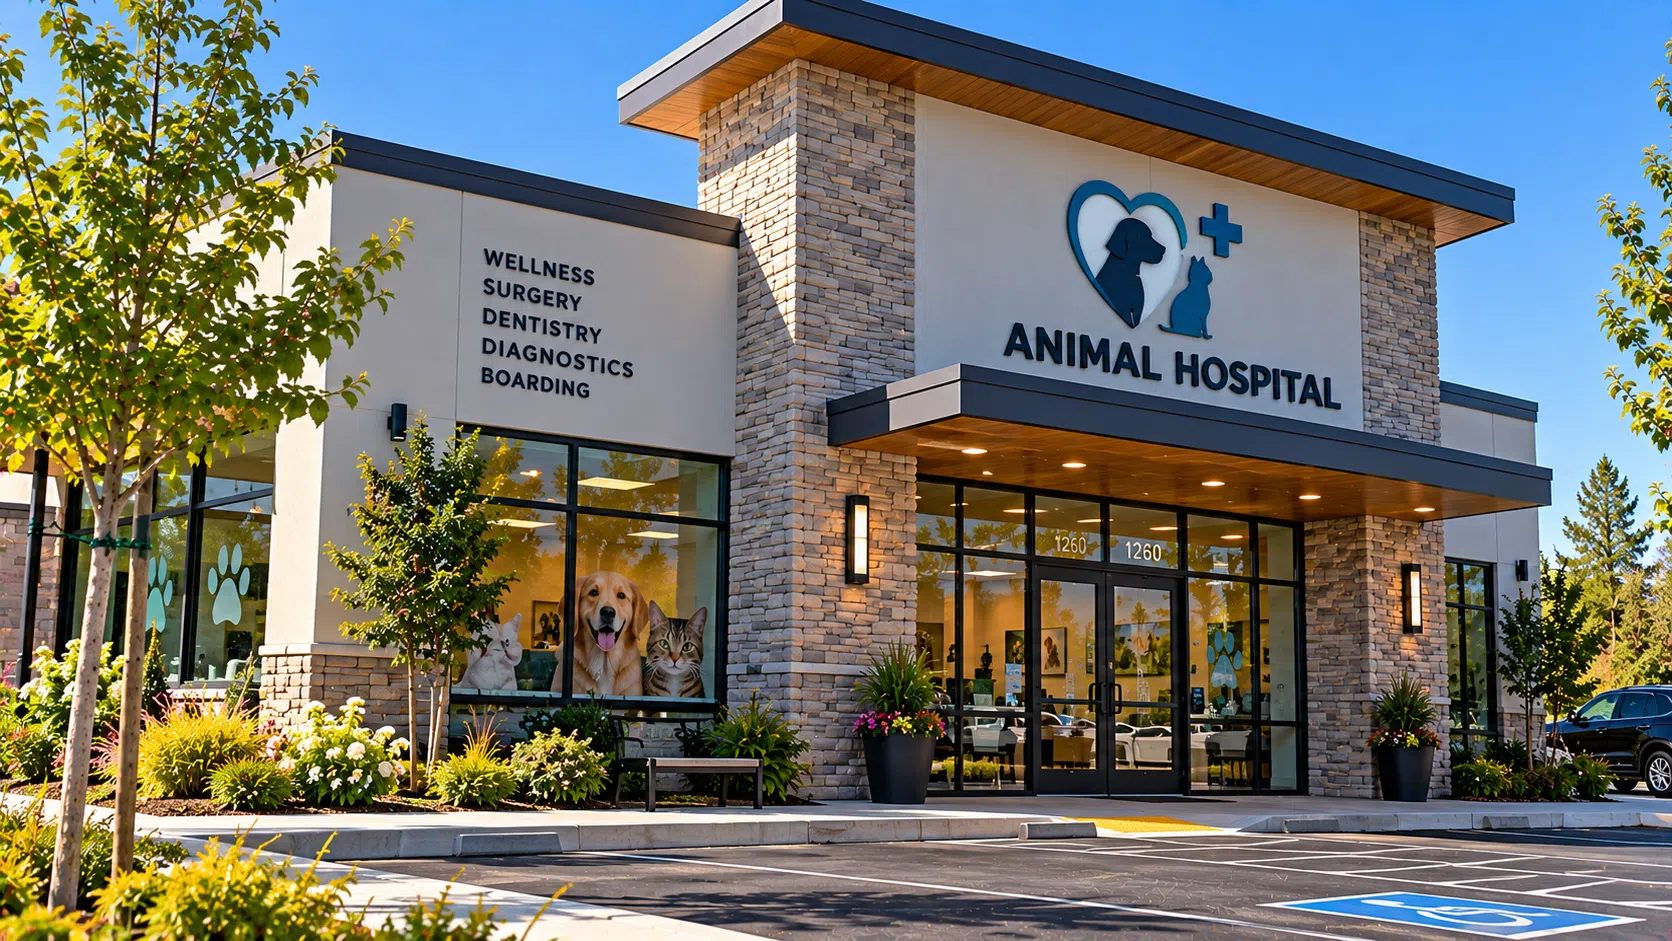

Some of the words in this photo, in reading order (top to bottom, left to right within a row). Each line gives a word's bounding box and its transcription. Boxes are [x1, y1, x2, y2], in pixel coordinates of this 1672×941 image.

[483, 248, 595, 286] WELLNESS
[483, 278, 582, 312] SURGERY
[482, 307, 602, 344] DENTISTRY
[481, 337, 634, 378] DIAGNOSTICS
[1003, 322, 1162, 381] ANIMAL
[1175, 351, 1342, 411] HOSPITAL
[481, 366, 590, 399] BOARDING
[1055, 535, 1087, 555] 1260
[1125, 541, 1162, 562] 1260
